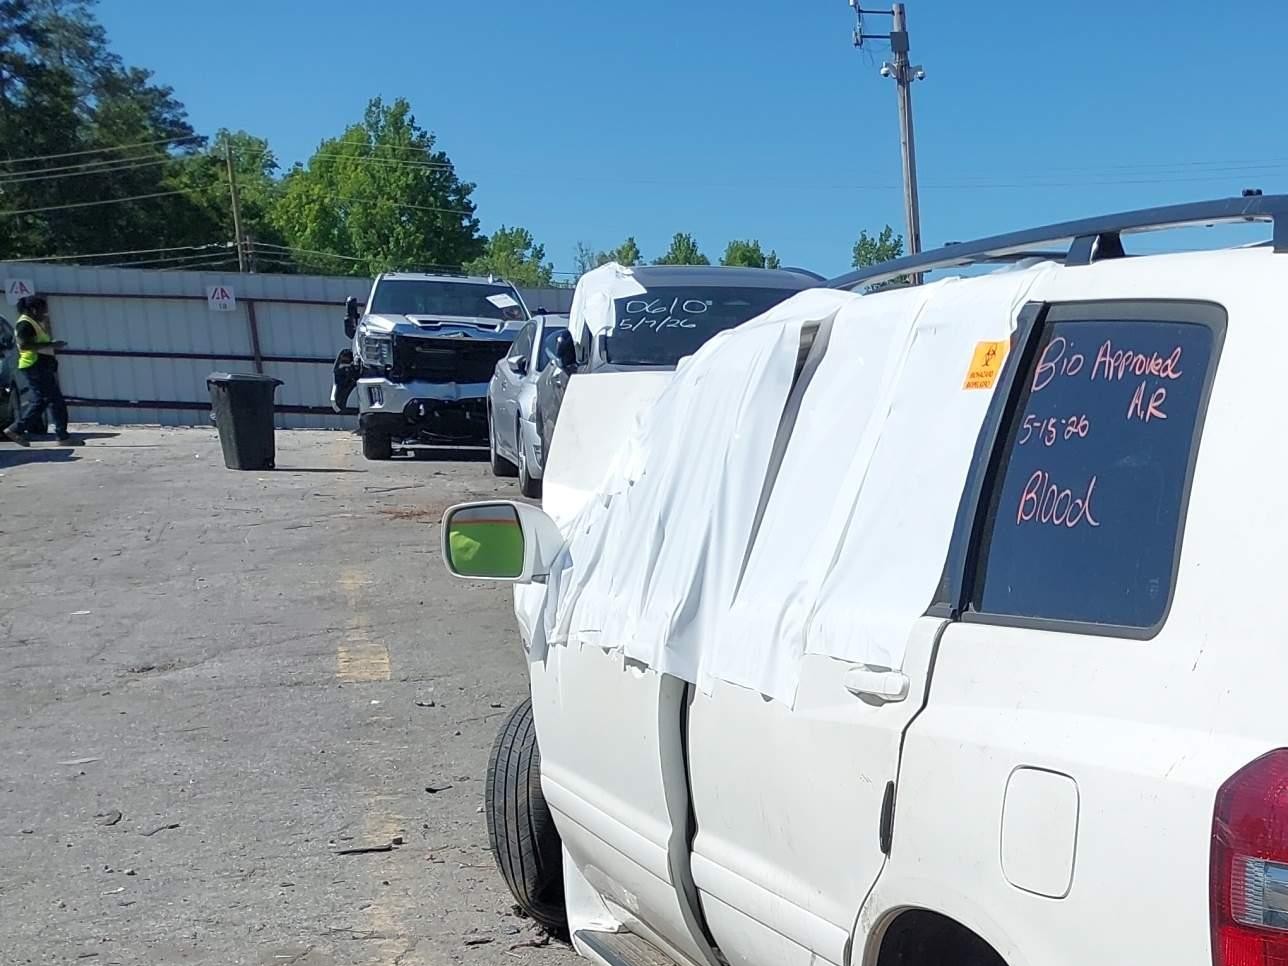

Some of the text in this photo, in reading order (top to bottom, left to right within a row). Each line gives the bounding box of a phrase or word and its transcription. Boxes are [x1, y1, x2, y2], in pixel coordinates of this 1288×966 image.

[1031, 336, 1183, 392] Bio Approved
[1016, 469, 1100, 528] Blood
